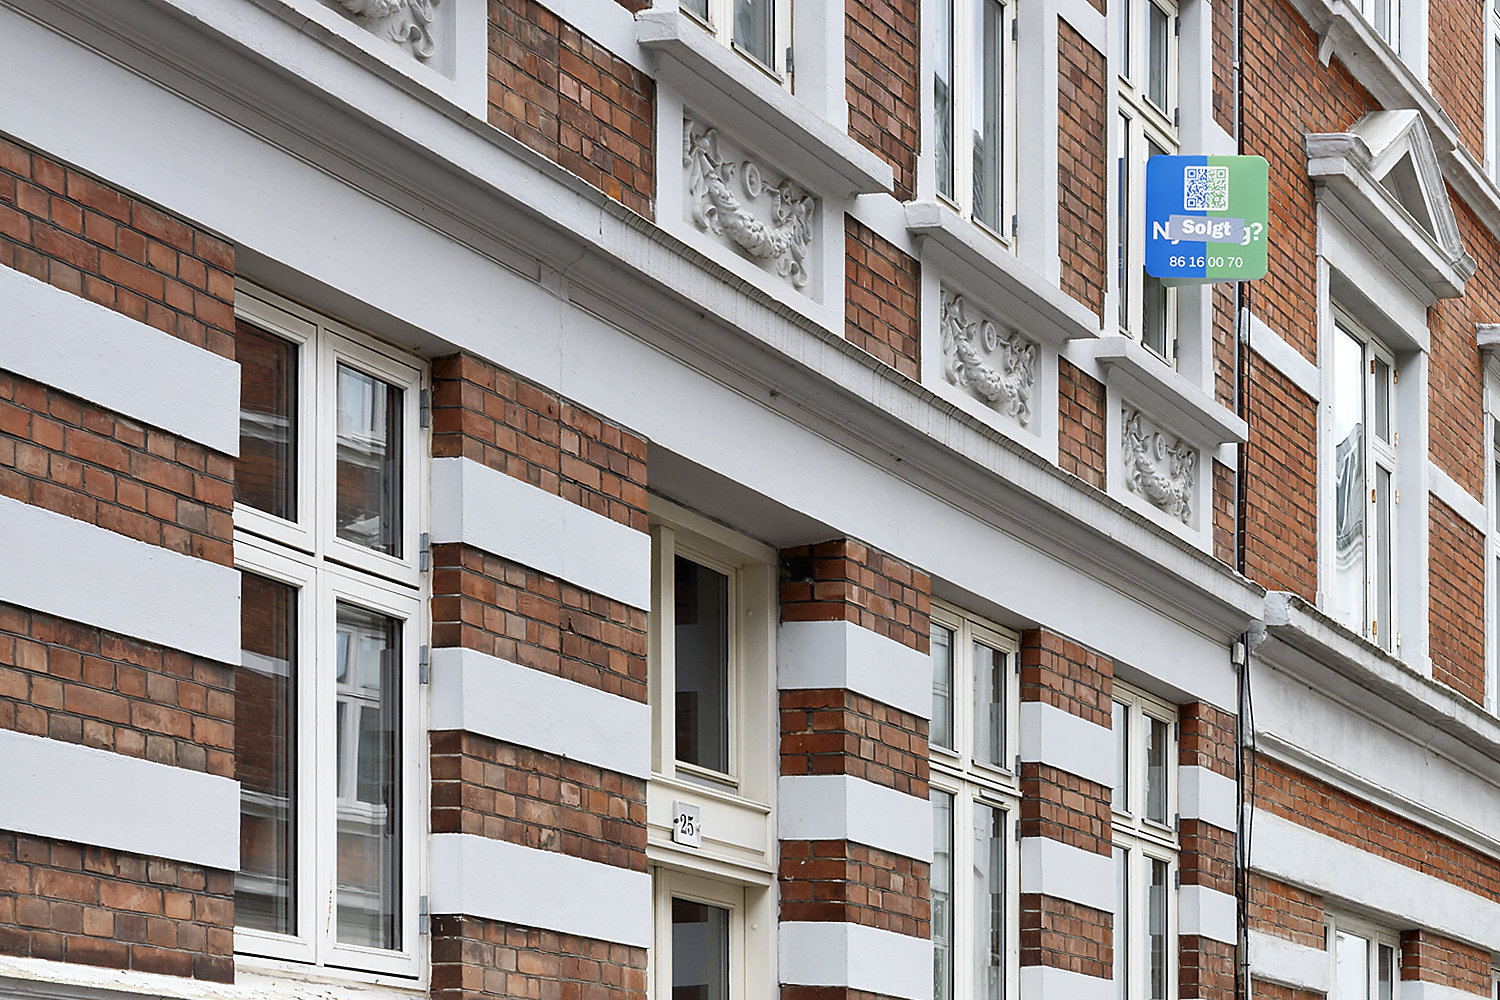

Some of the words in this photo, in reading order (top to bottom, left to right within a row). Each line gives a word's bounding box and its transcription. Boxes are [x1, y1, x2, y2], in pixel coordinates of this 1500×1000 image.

[1182, 220, 1231, 239] Solgt
[1169, 256, 1186, 268] 86
[1190, 256, 1204, 268] 16
[1208, 256, 1224, 268] 00
[1228, 256, 1243, 268] 70
[680, 813, 694, 836] 25
